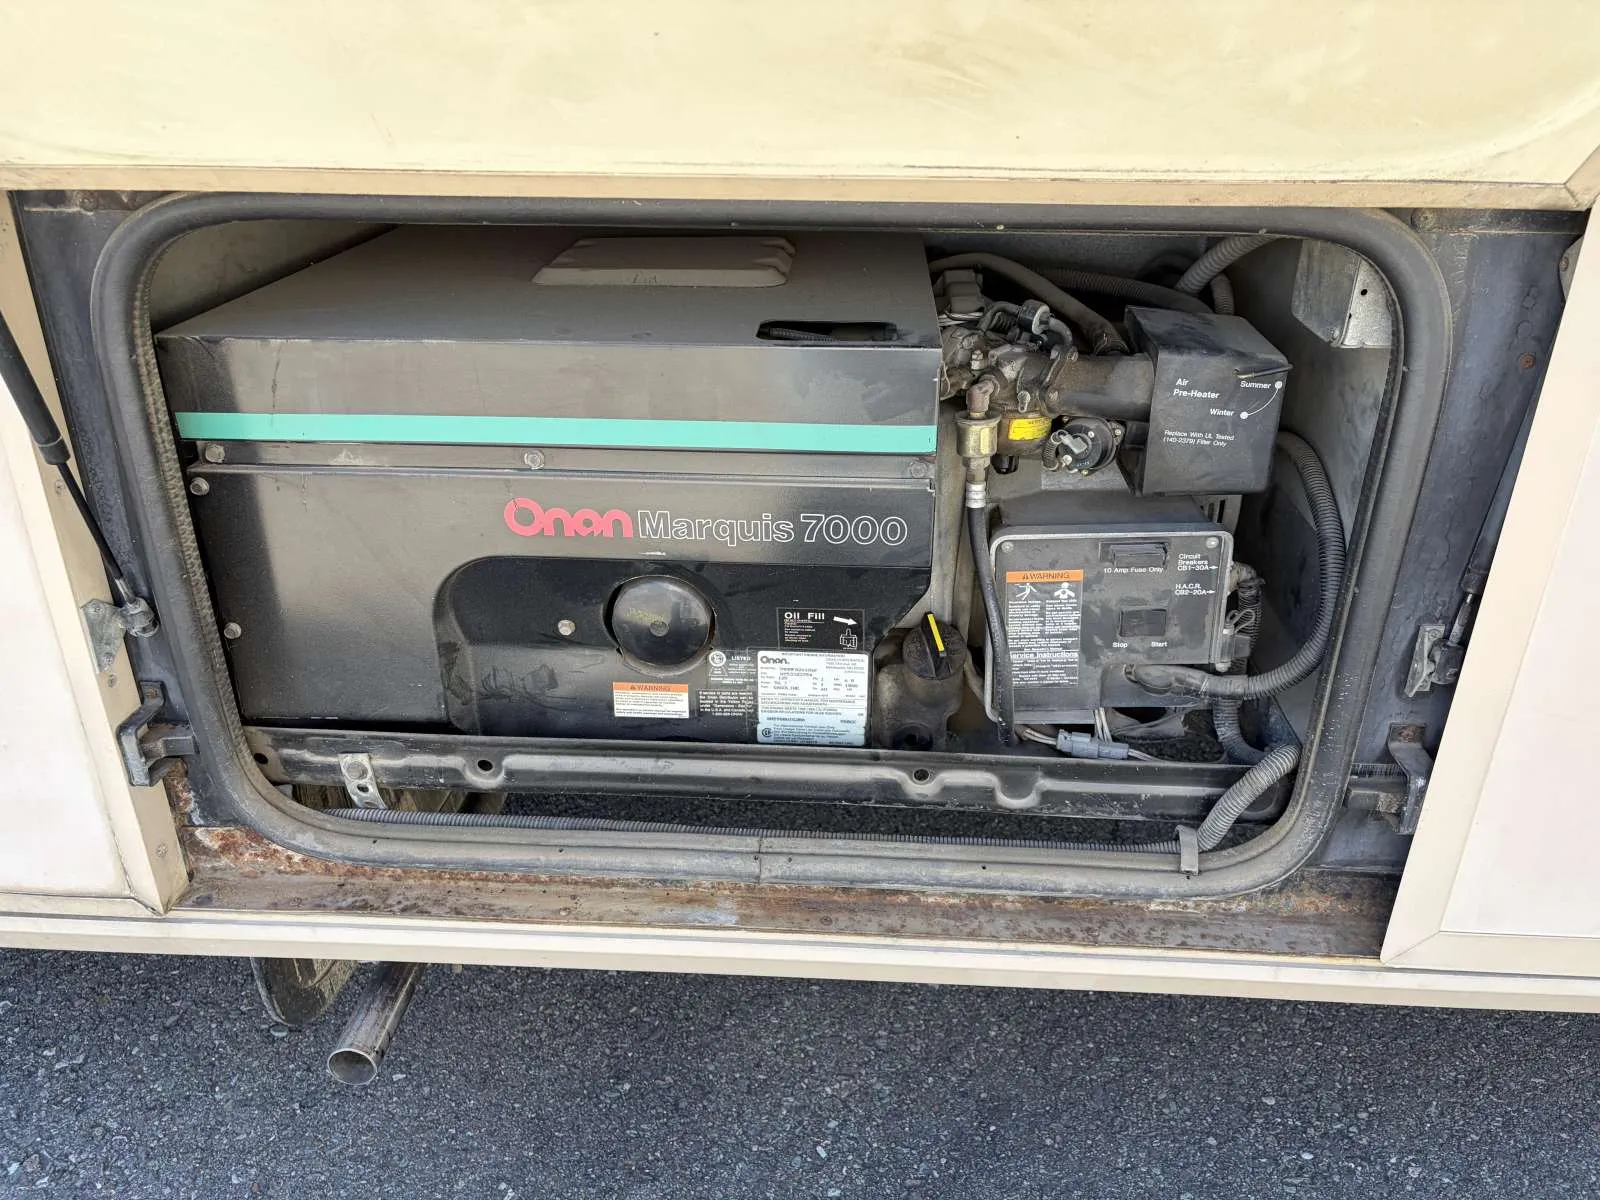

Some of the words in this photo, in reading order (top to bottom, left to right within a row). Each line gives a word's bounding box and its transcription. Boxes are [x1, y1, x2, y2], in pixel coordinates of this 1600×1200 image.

[1175, 378, 1189, 386] Air
[1240, 380, 1272, 389] Summer
[1173, 388, 1220, 399] Pre-Heater
[1209, 408, 1235, 417] Winter
[1164, 430, 1188, 438] Replace
[1196, 438, 1211, 446] Filter
[1213, 439, 1228, 448] Only
[503, 497, 634, 539] Onan
[637, 509, 796, 547] Marquis
[800, 513, 908, 546] 7000
[1113, 567, 1129, 575] Amp
[1130, 566, 1147, 574] Fuse
[1148, 566, 1164, 575] Only
[1028, 571, 1070, 580] WARNING
[784, 611, 800, 620] Oil
[807, 612, 825, 620] Fill
[1112, 641, 1128, 649] Stop
[1010, 651, 1035, 659] ervice
[1036, 650, 1079, 659] Instructions
[637, 684, 671, 692] WARNING
